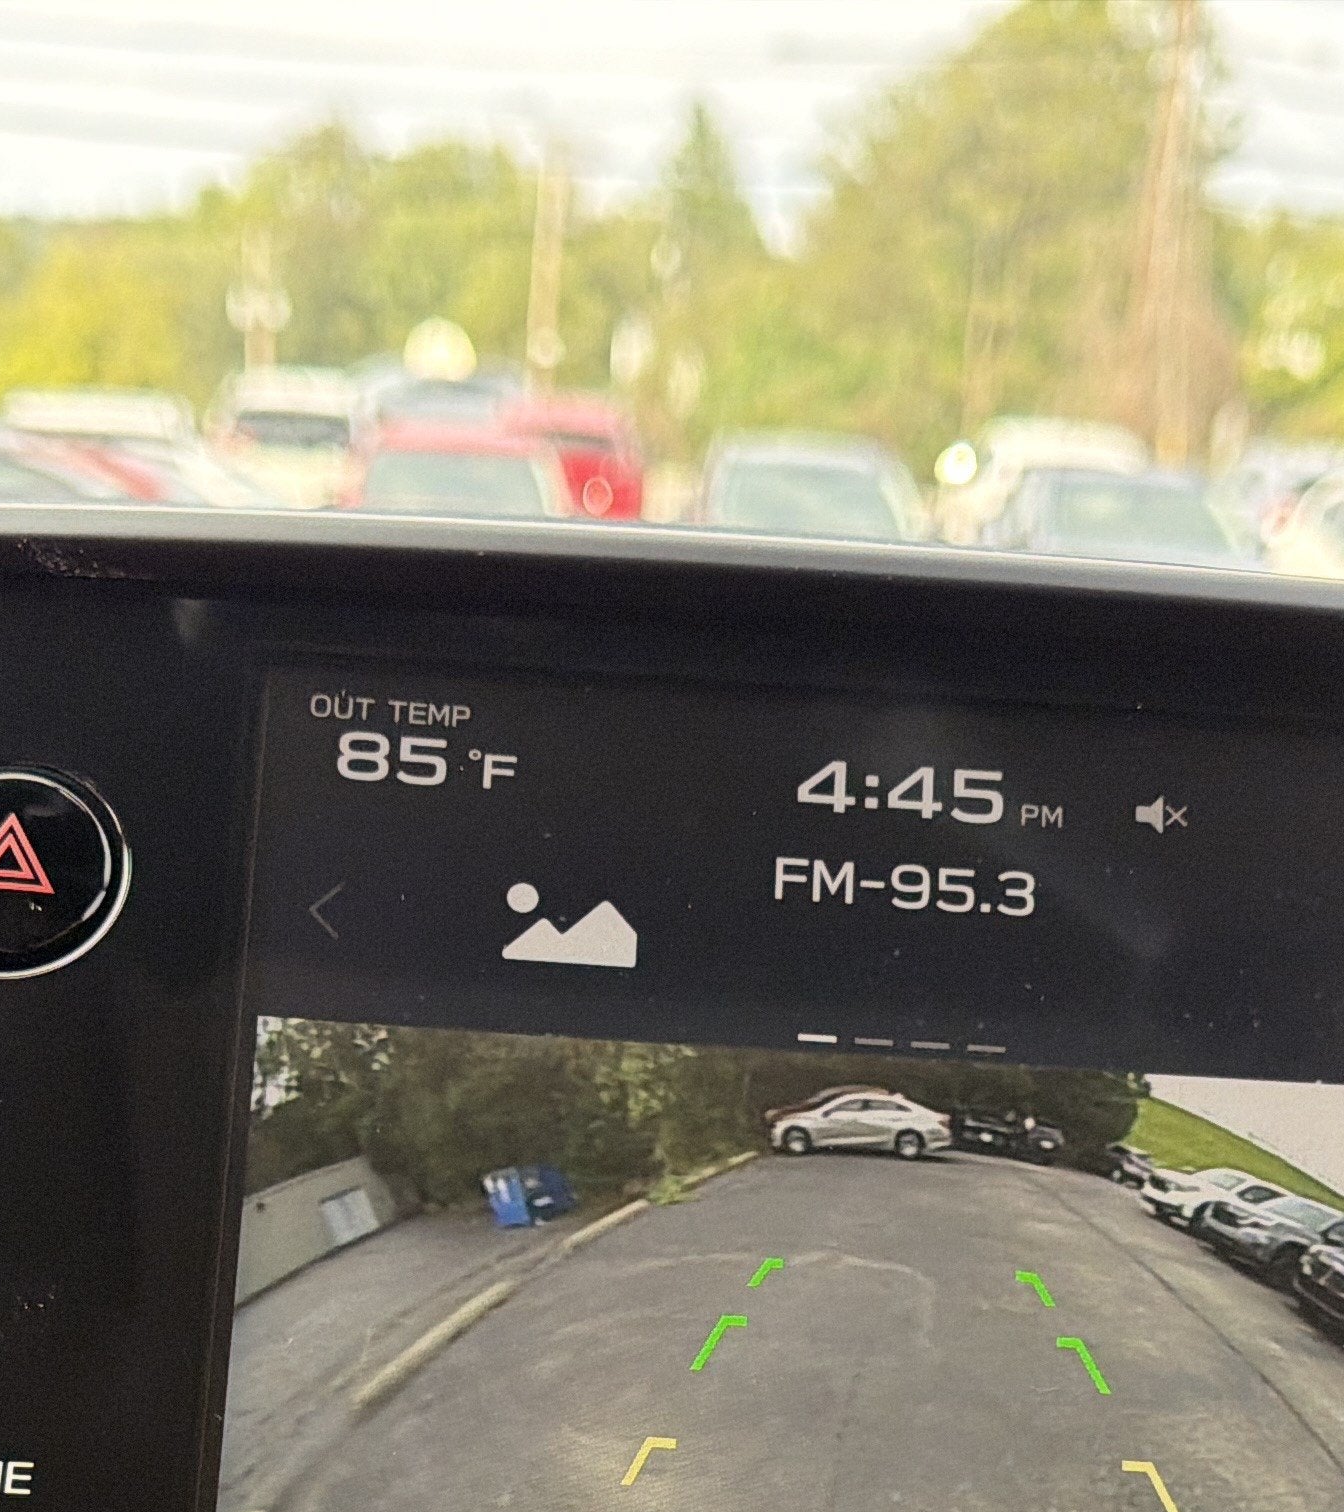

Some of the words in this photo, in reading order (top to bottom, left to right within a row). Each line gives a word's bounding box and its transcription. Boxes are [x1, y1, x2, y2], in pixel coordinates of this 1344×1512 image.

[310, 693, 375, 720] OUT
[388, 700, 471, 727] TEMP
[337, 731, 447, 786] 85
[798, 761, 1004, 824] 4:45
[1020, 804, 1064, 829] PM
[774, 856, 1035, 917] FM-95.3
